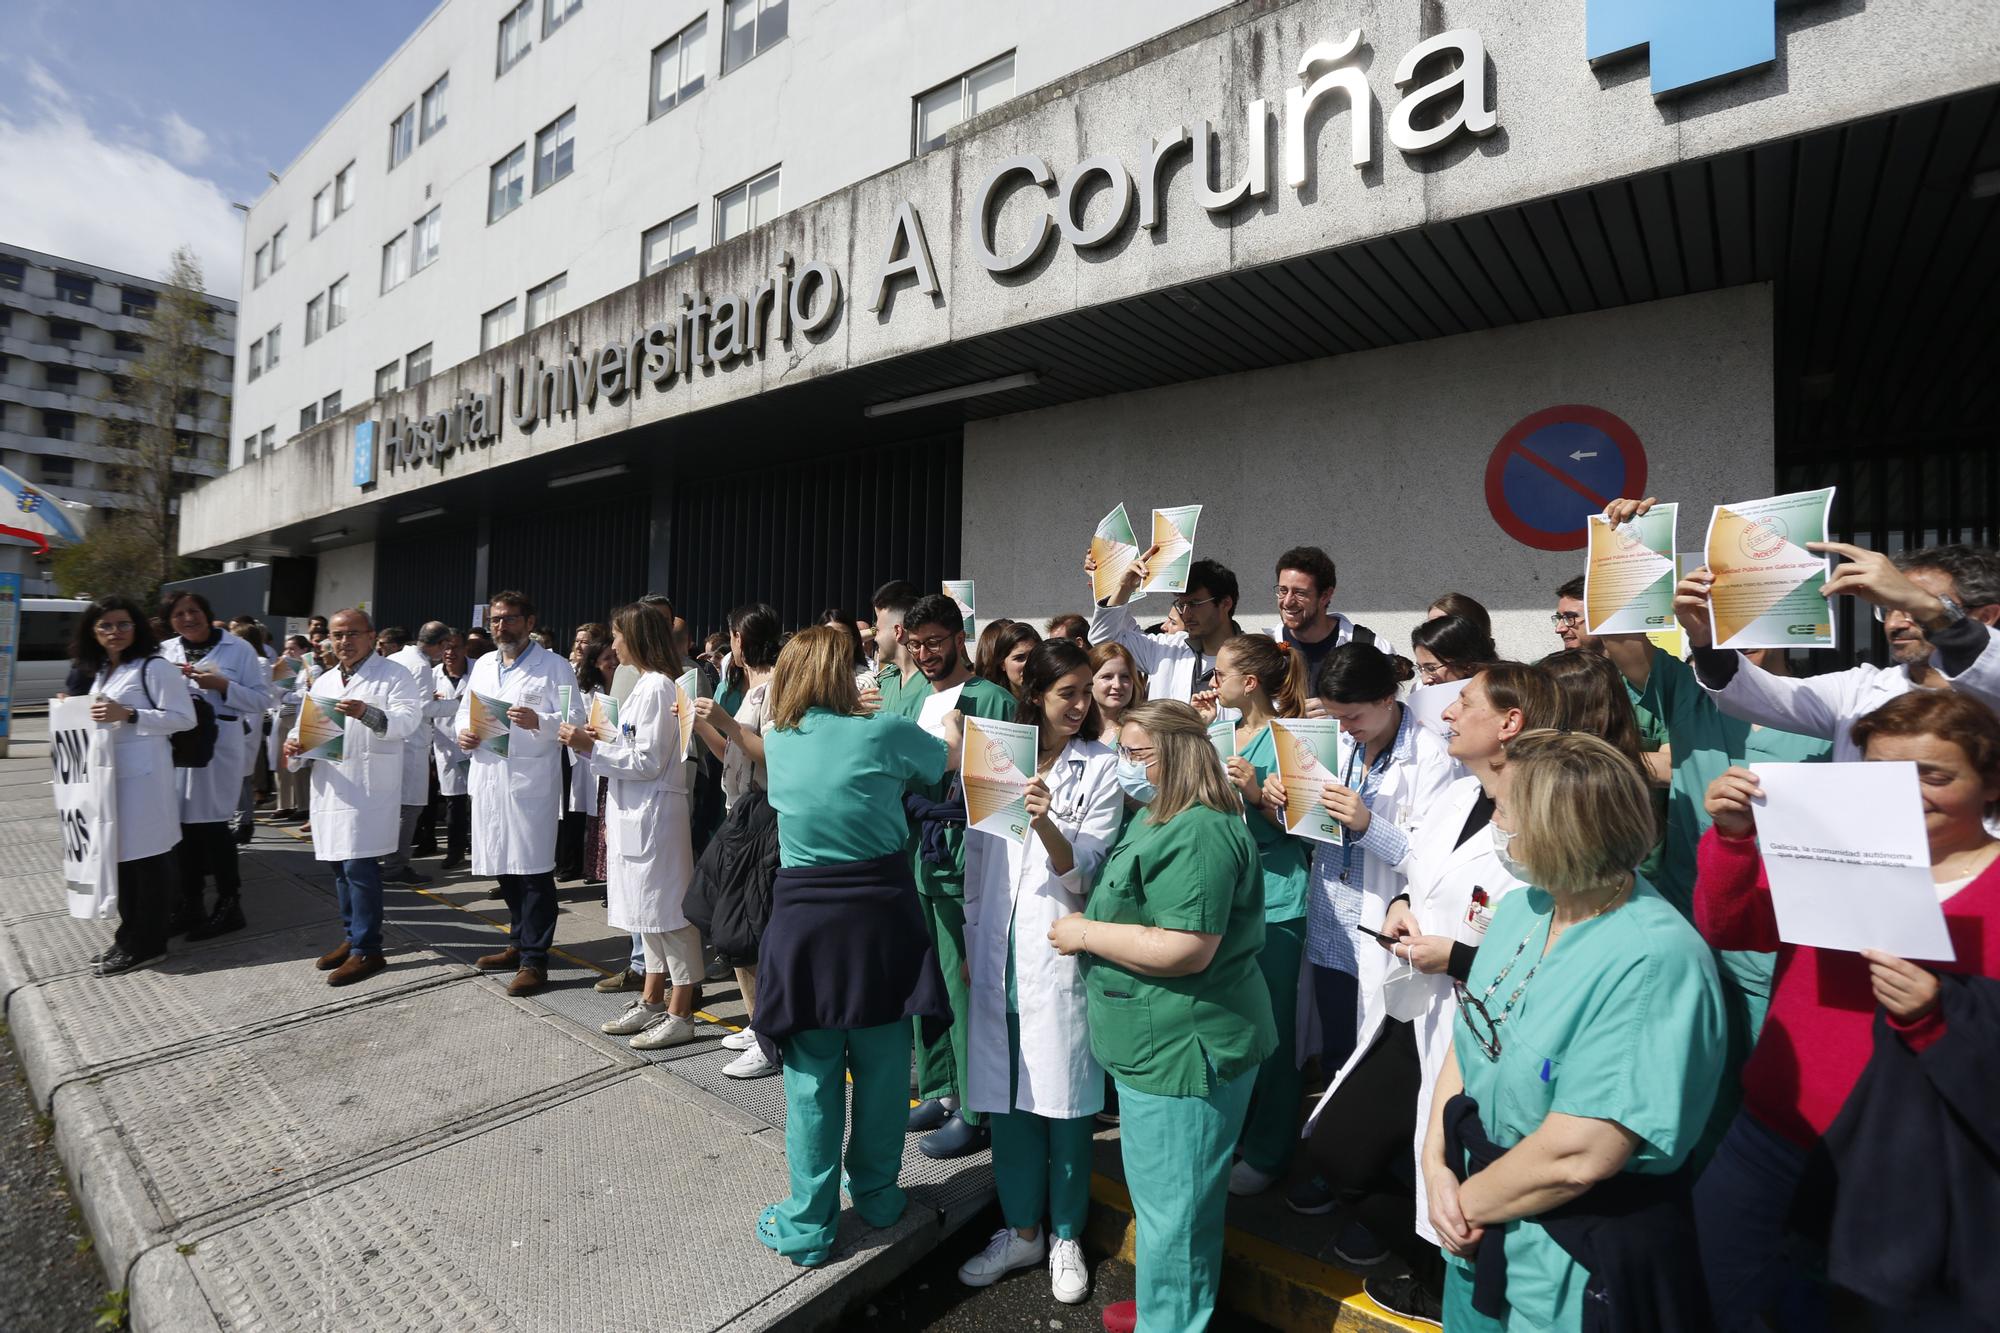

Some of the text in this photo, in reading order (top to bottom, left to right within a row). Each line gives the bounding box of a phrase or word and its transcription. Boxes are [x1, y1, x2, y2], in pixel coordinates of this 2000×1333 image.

[384, 28, 1498, 470] Hospital Universitario A Coruña
[1811, 847, 1860, 858] comunidad
